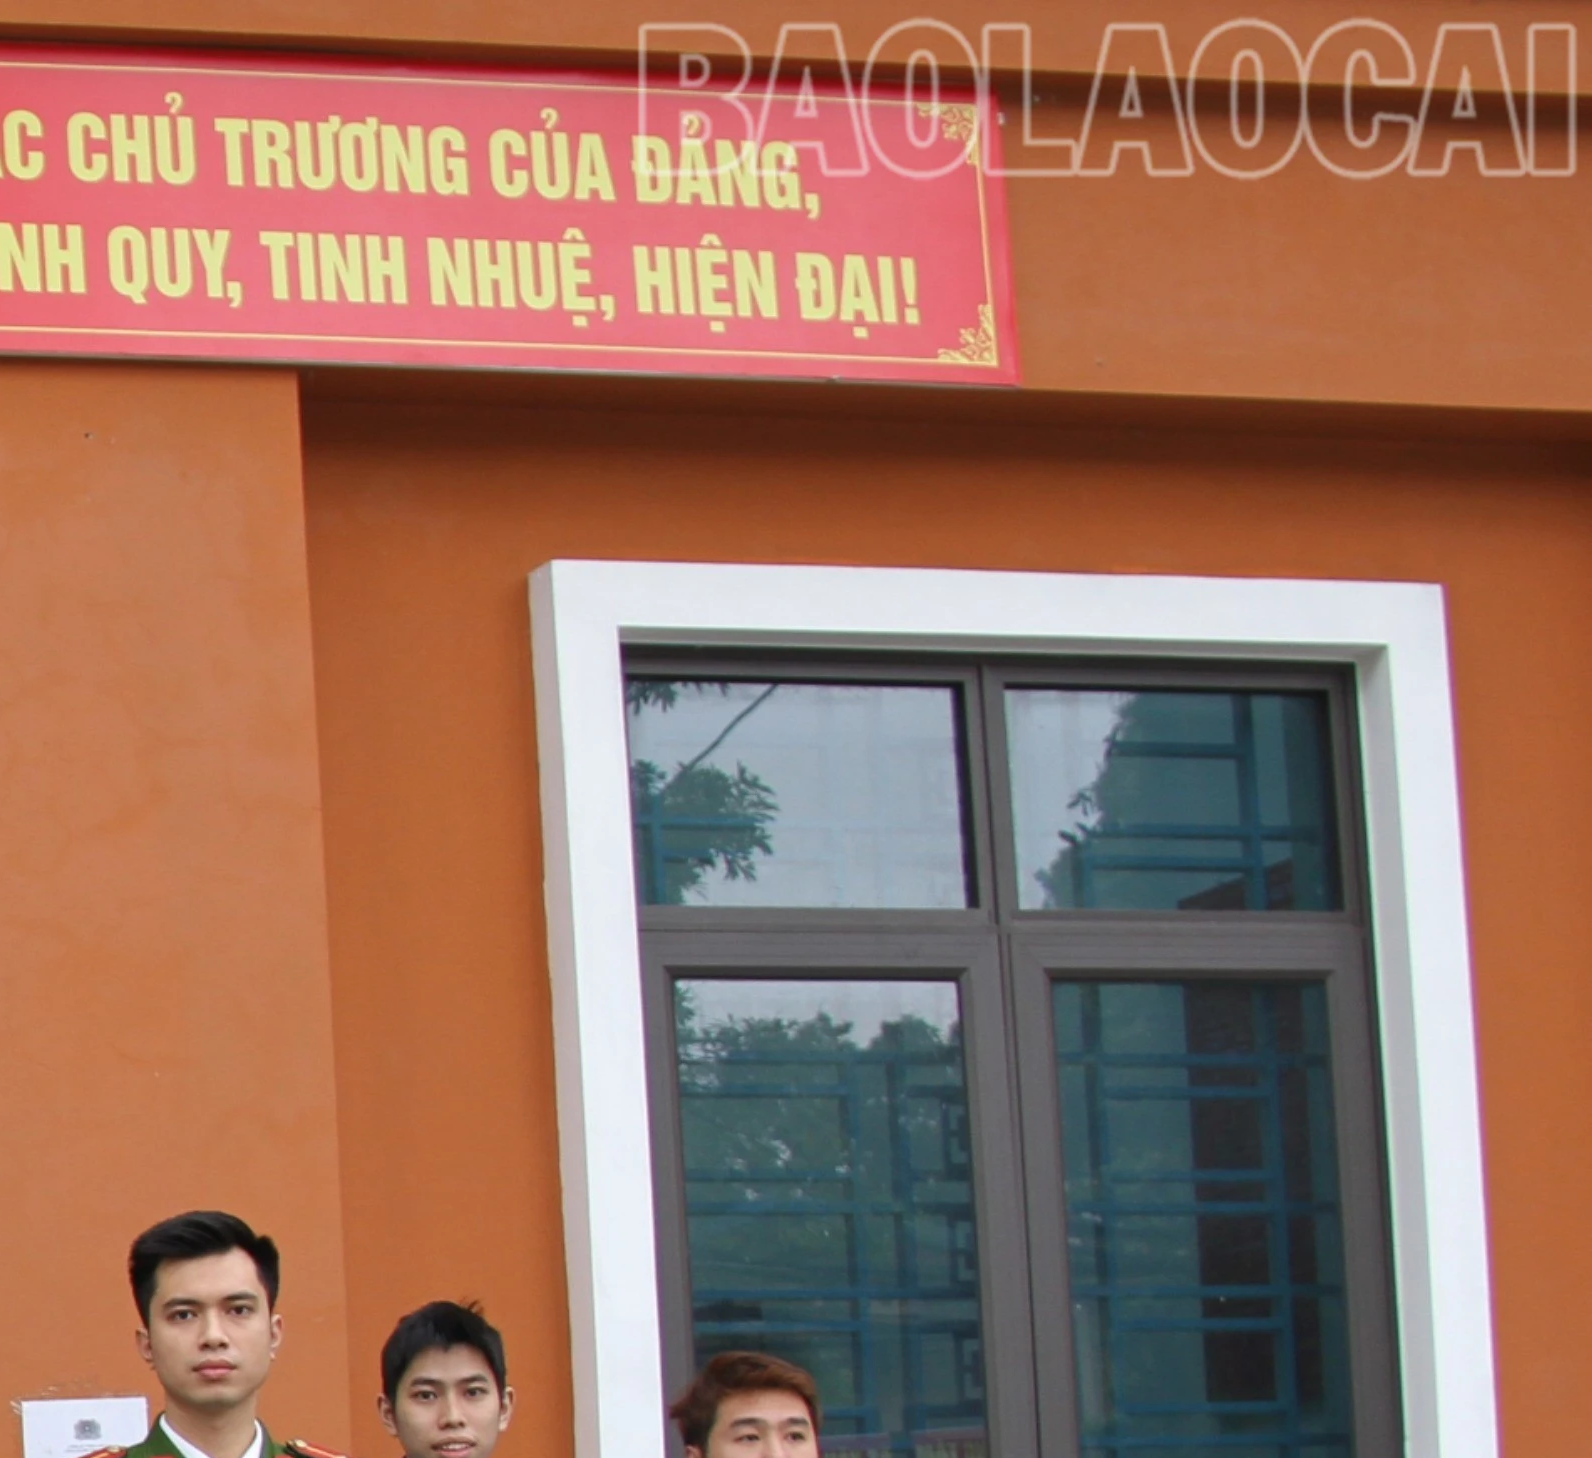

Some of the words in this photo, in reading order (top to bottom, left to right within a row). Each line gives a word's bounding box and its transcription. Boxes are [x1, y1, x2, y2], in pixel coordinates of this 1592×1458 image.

[67, 90, 197, 186] CHỦ
[214, 116, 470, 196] TRƯƠNG
[489, 108, 616, 202] CỦA
[632, 109, 820, 218] ĐẢNG,
[107, 225, 244, 309] QUY,
[260, 231, 409, 305] TINH
[428, 228, 616, 327] NHUỆ,
[633, 234, 779, 330] HIỆN
[795, 252, 920, 330] ĐẠI!
